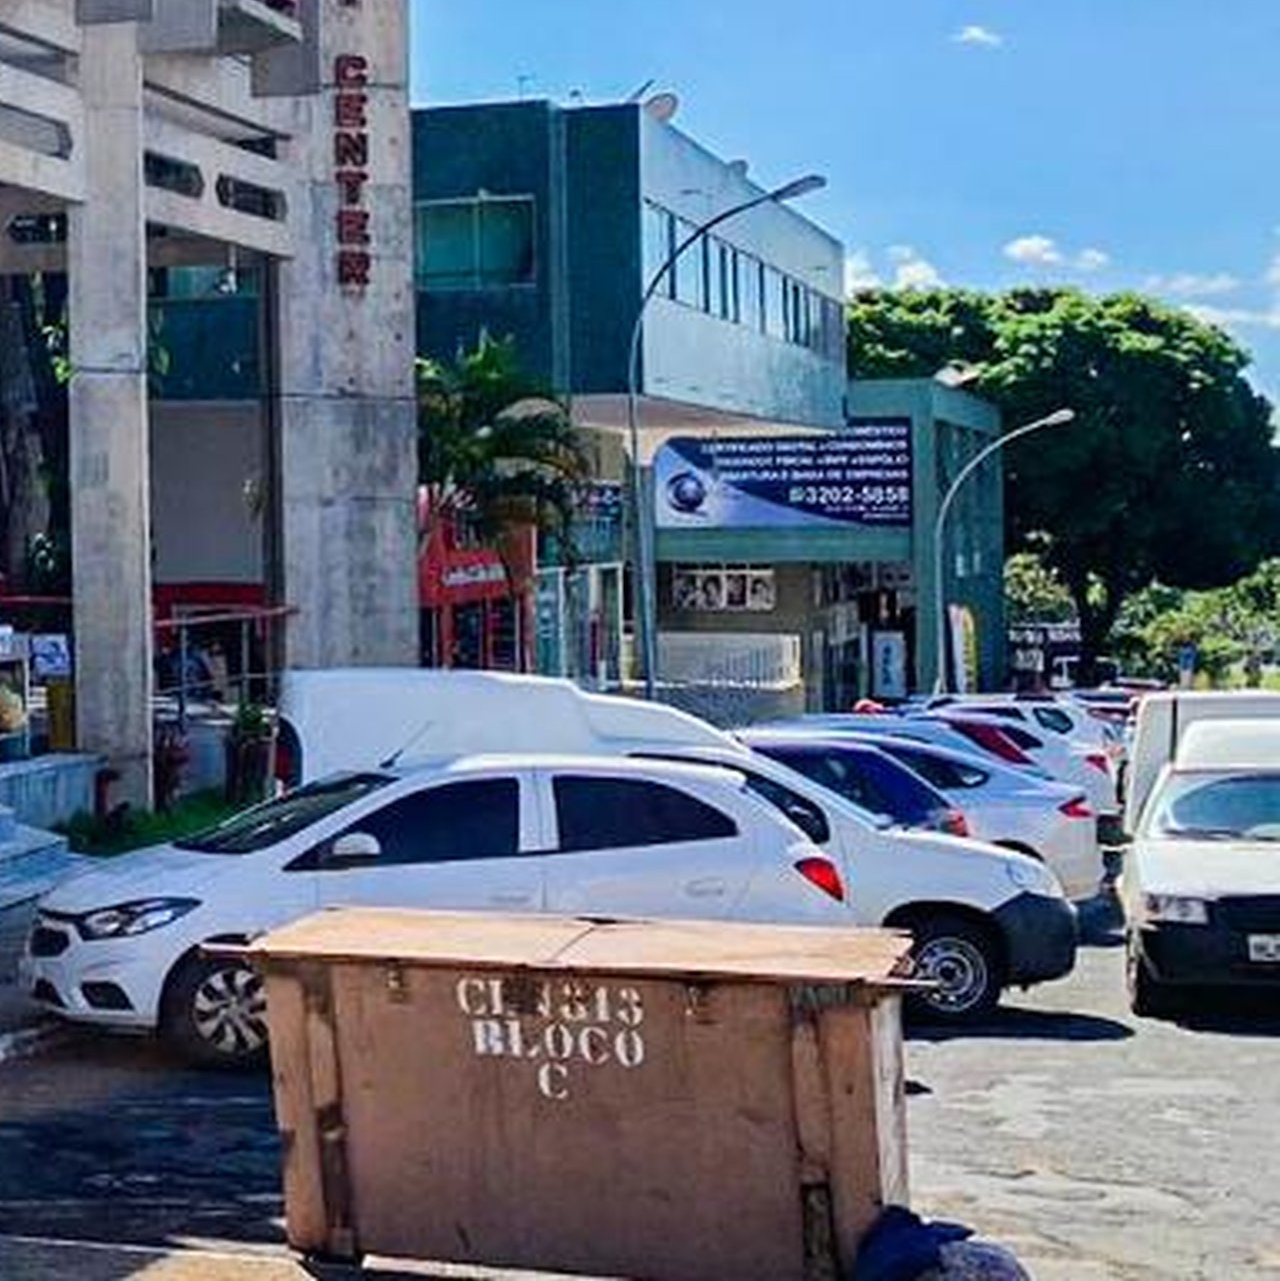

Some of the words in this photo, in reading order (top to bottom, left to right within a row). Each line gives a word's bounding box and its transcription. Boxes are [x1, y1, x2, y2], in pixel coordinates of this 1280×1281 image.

[334, 54, 372, 287] CENTER
[472, 1018, 645, 1068] BLOCO
[537, 1061, 569, 1100] C
